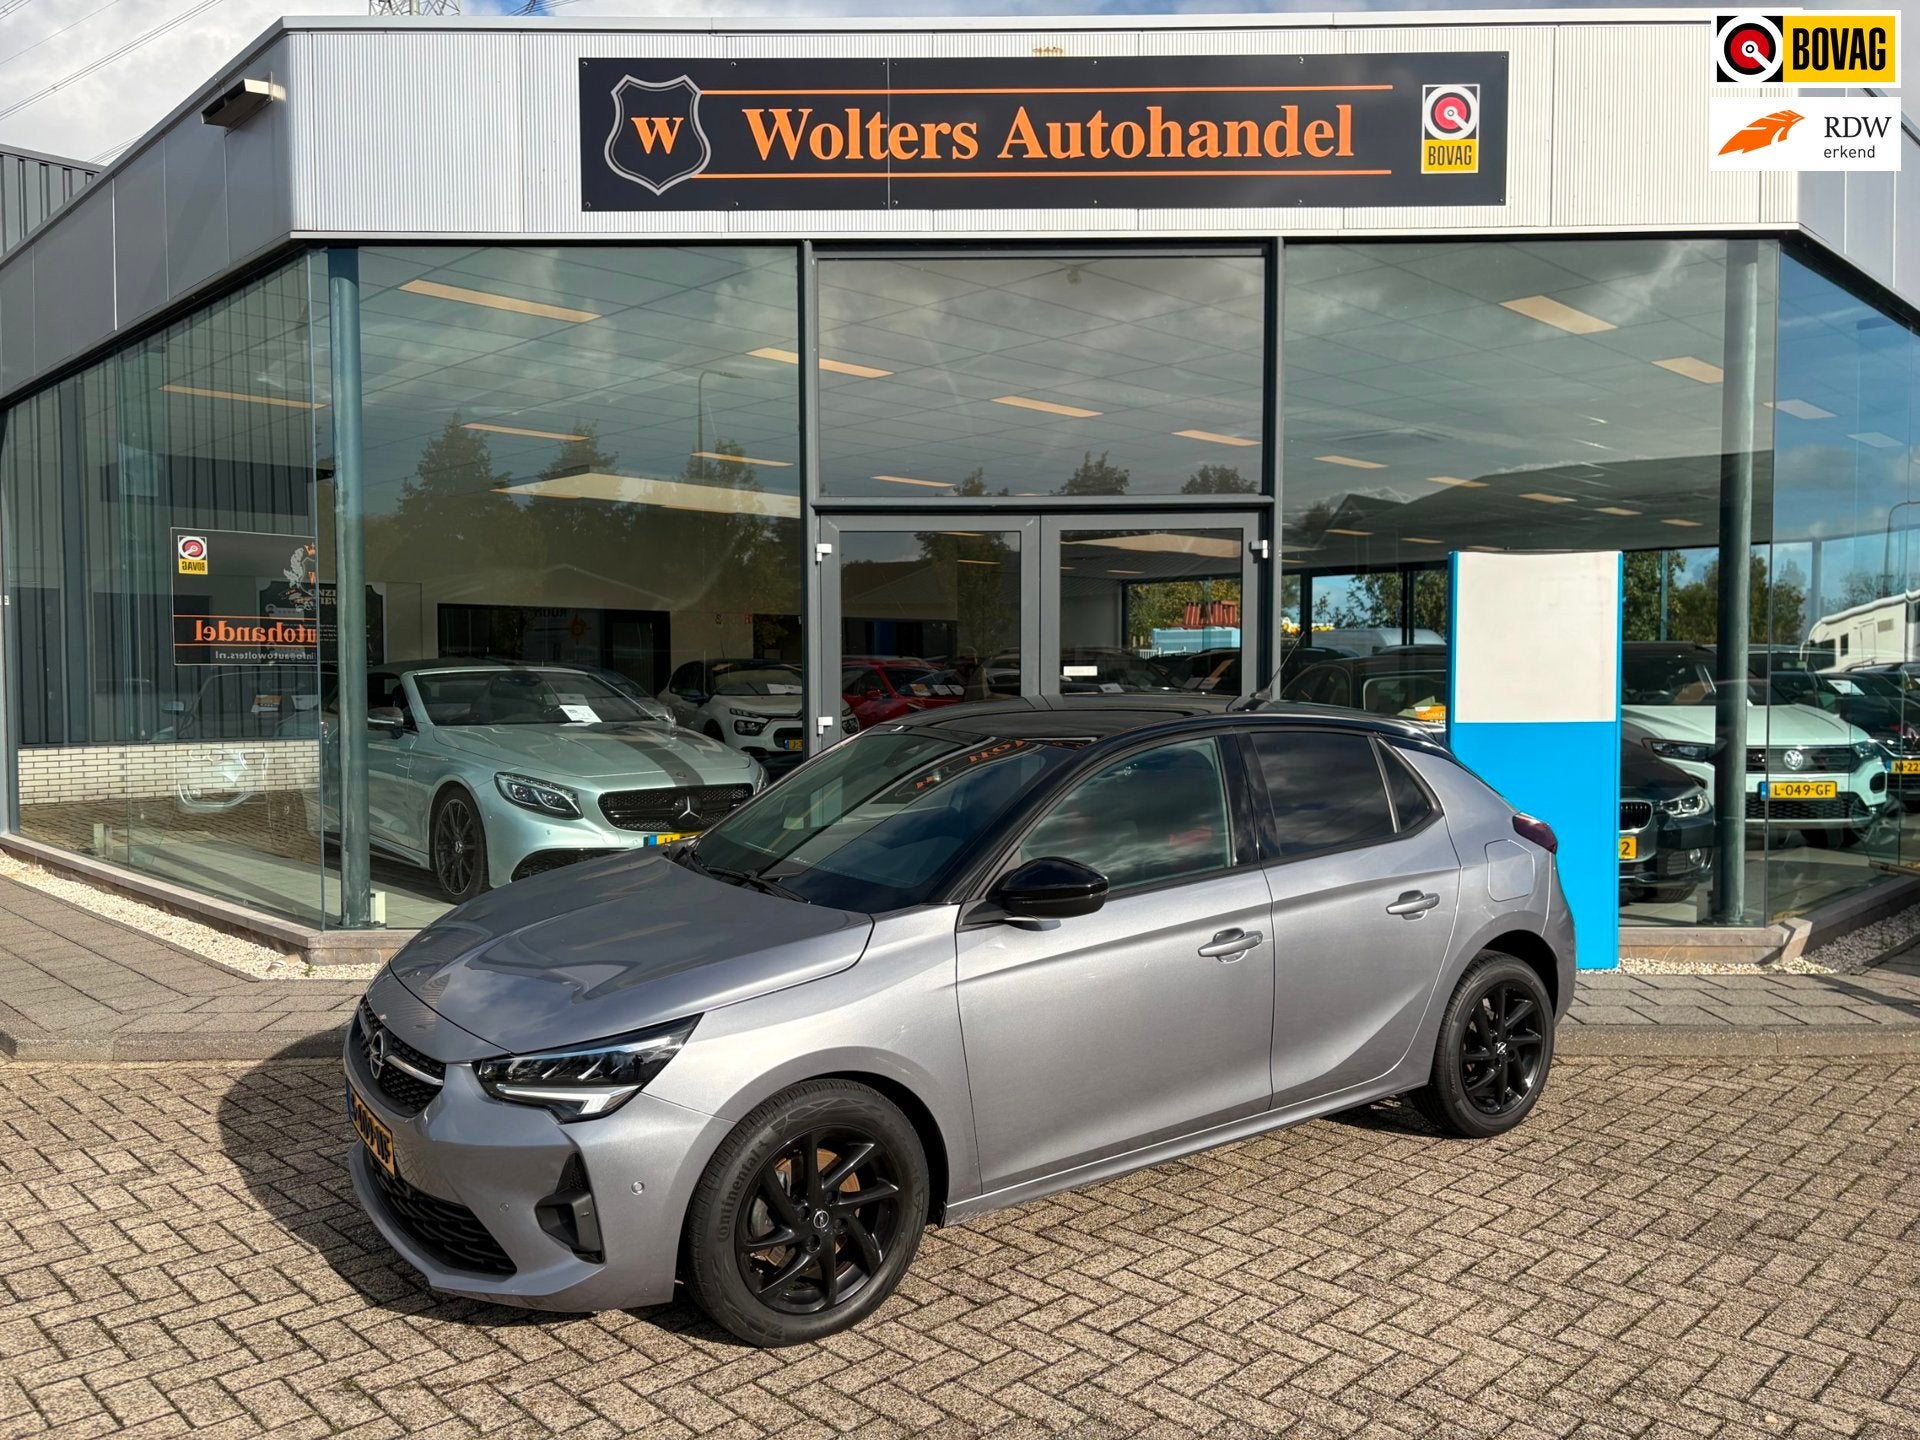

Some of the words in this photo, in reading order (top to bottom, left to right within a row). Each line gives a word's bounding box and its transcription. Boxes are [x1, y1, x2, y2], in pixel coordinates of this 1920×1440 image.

[631, 117, 684, 154] W
[743, 107, 979, 161] Wolters
[997, 104, 1354, 160] Autohandel
[1427, 145, 1473, 167] BOVAG
[1774, 785, 1831, 796] L-049-GF
